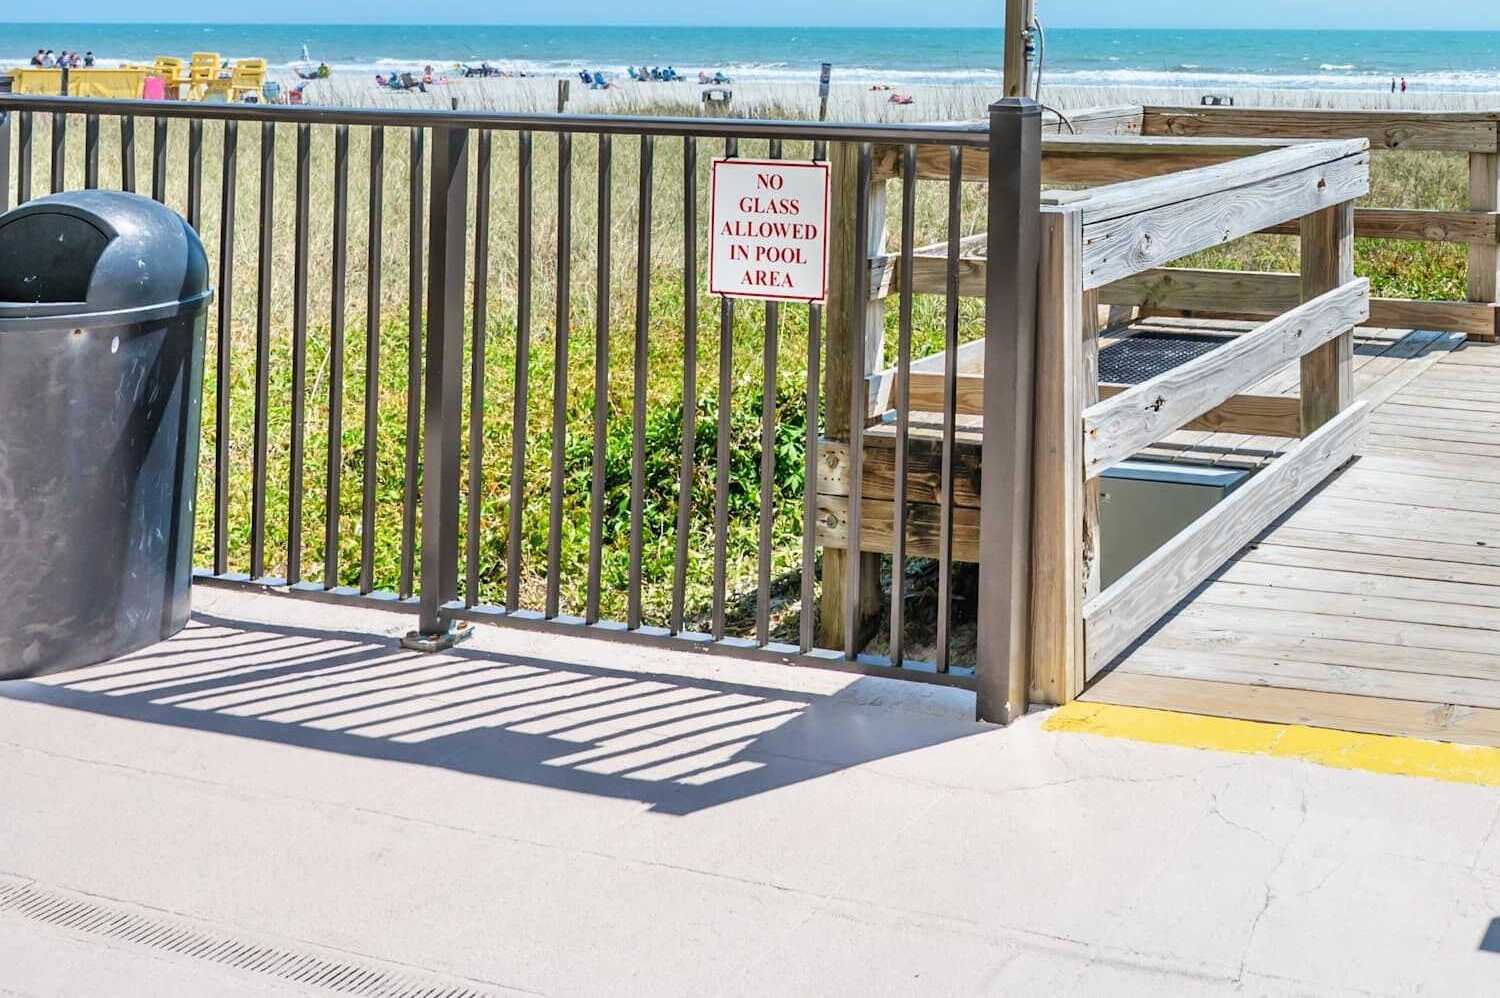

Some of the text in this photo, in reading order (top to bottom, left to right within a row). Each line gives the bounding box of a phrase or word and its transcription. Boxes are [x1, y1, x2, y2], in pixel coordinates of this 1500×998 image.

[757, 173, 783, 190] NO
[739, 196, 800, 215] GLASS
[720, 220, 818, 240] ALLOWED
[730, 244, 807, 264] IN POOL
[741, 269, 794, 288] AREA
